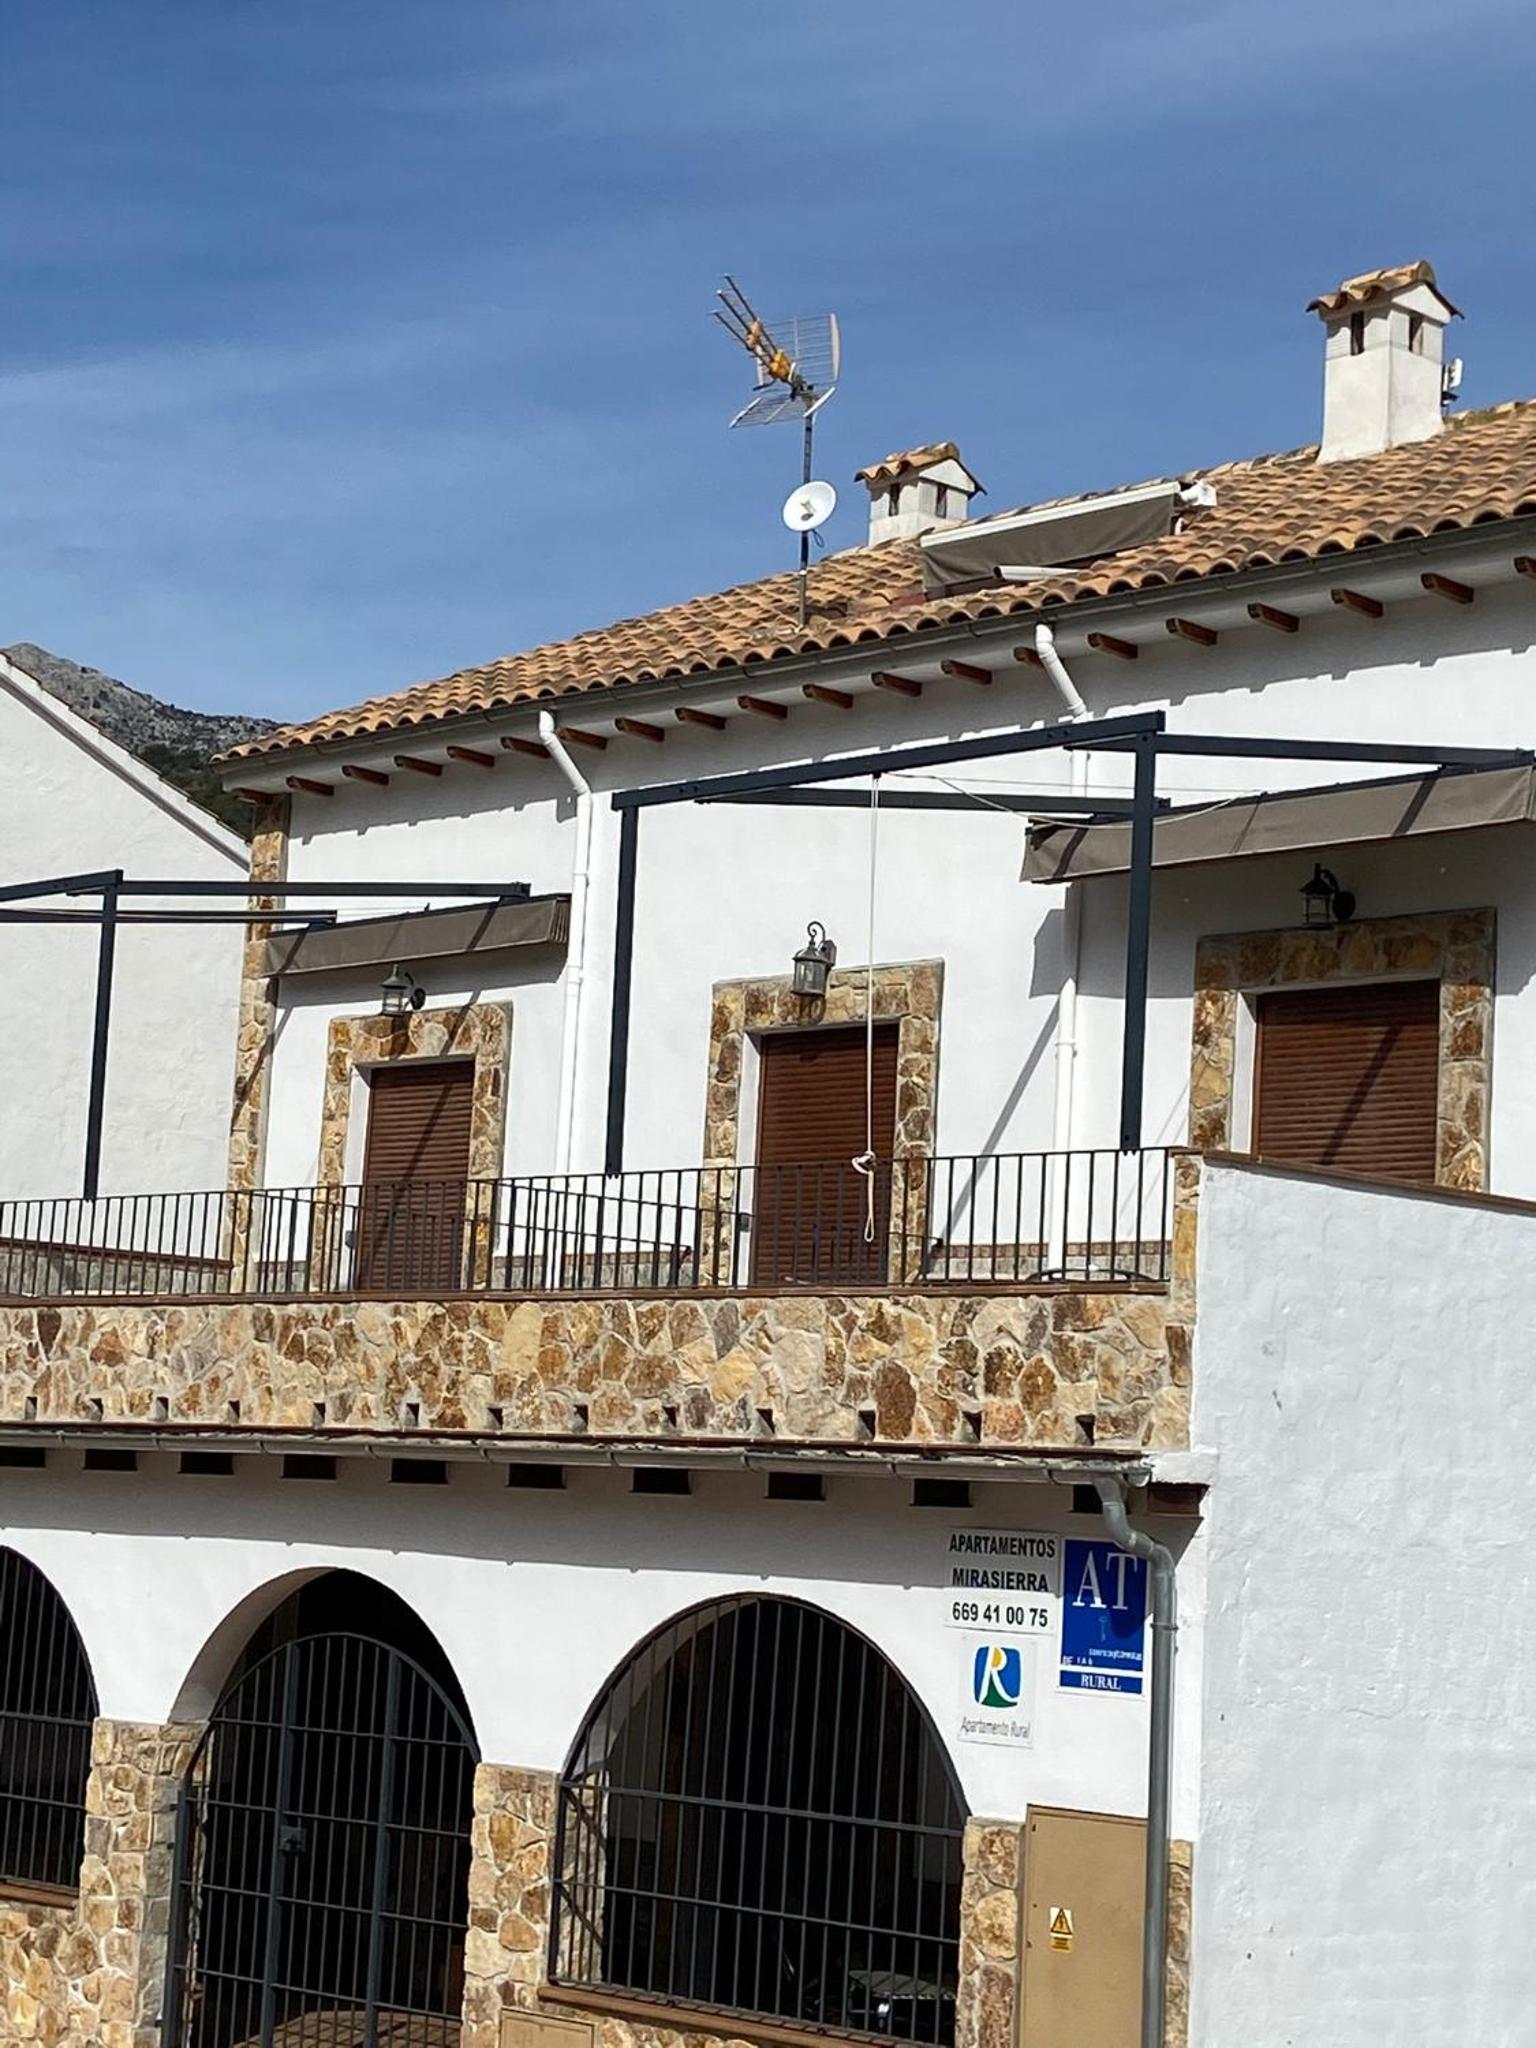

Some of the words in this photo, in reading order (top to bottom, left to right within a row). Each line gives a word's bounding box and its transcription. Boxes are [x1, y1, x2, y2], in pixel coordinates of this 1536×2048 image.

[949, 1533, 1056, 1558] APARTAMENTOS
[952, 1568, 1049, 1592] MIRASIERRA
[1072, 1549, 1139, 1610] AT
[952, 1602, 979, 1622] 669
[983, 1604, 1000, 1624] 41
[1006, 1606, 1024, 1625] 00
[1029, 1608, 1048, 1628] 75
[1080, 1674, 1122, 1691] RURAL
[960, 1717, 1009, 1738] Apartamento
[1011, 1721, 1031, 1739] Rural
